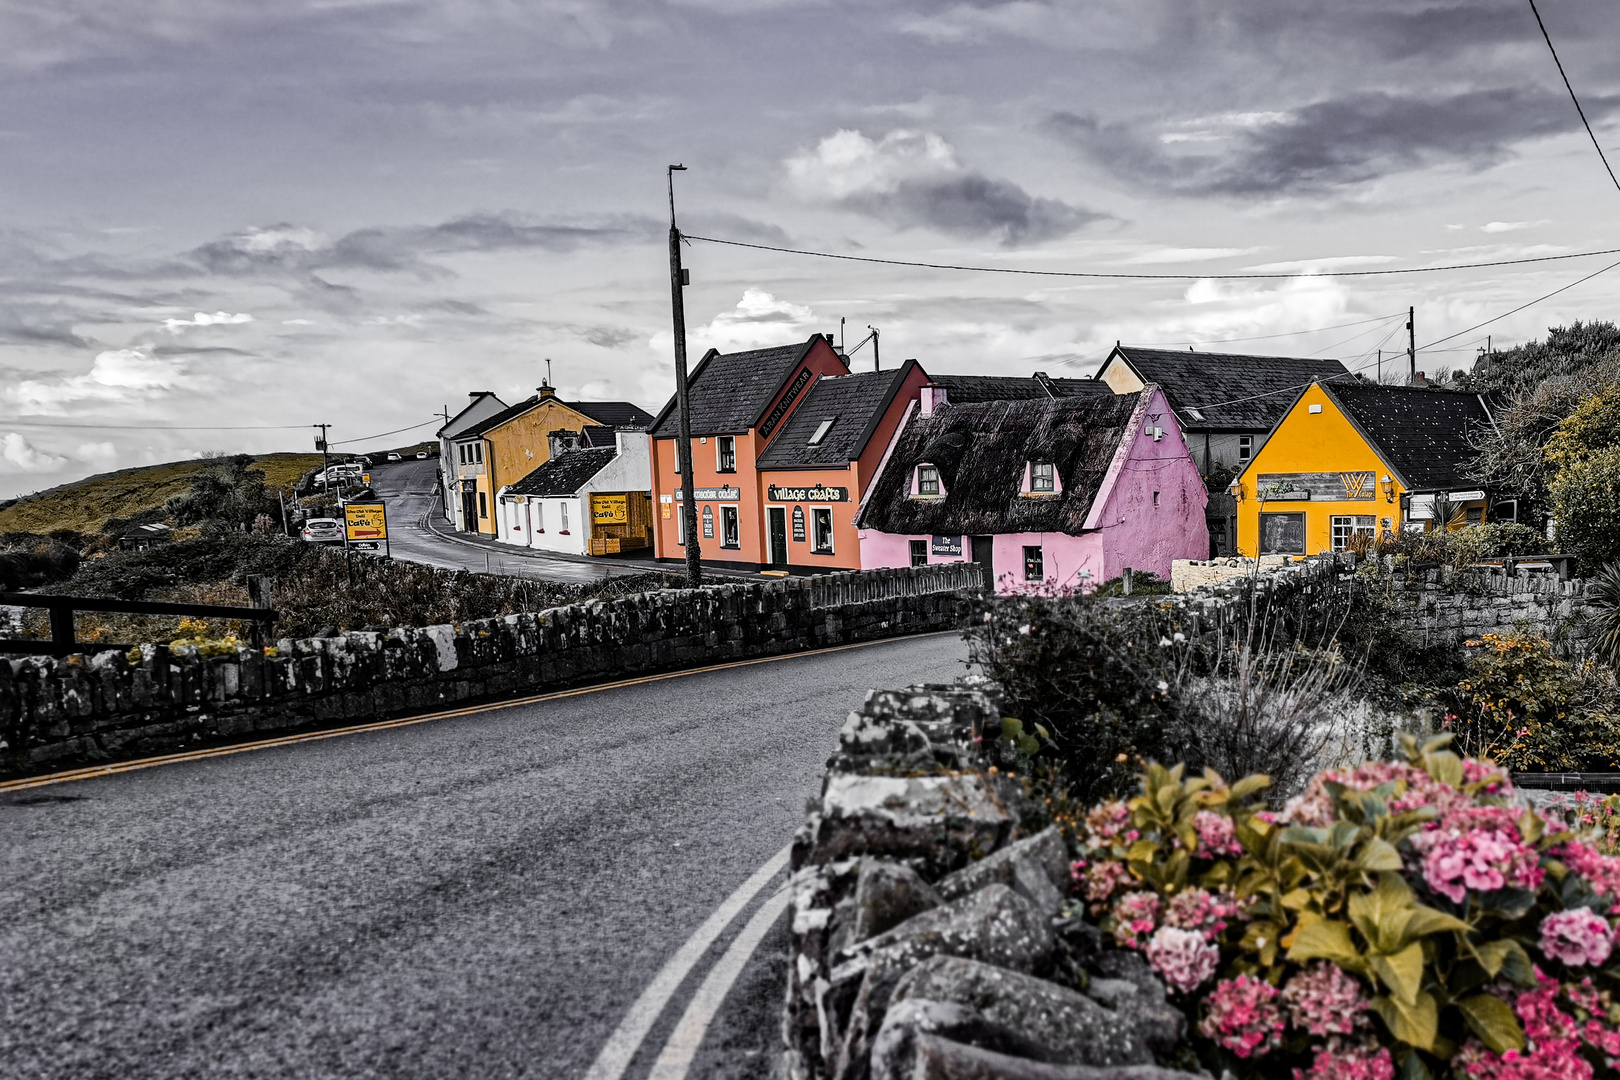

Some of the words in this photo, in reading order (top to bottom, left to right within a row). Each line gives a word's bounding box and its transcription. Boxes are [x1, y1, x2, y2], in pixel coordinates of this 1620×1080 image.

[762, 409, 781, 435] ARAN
[778, 371, 810, 412] KNITWEAR
[950, 544, 962, 554] Shop
